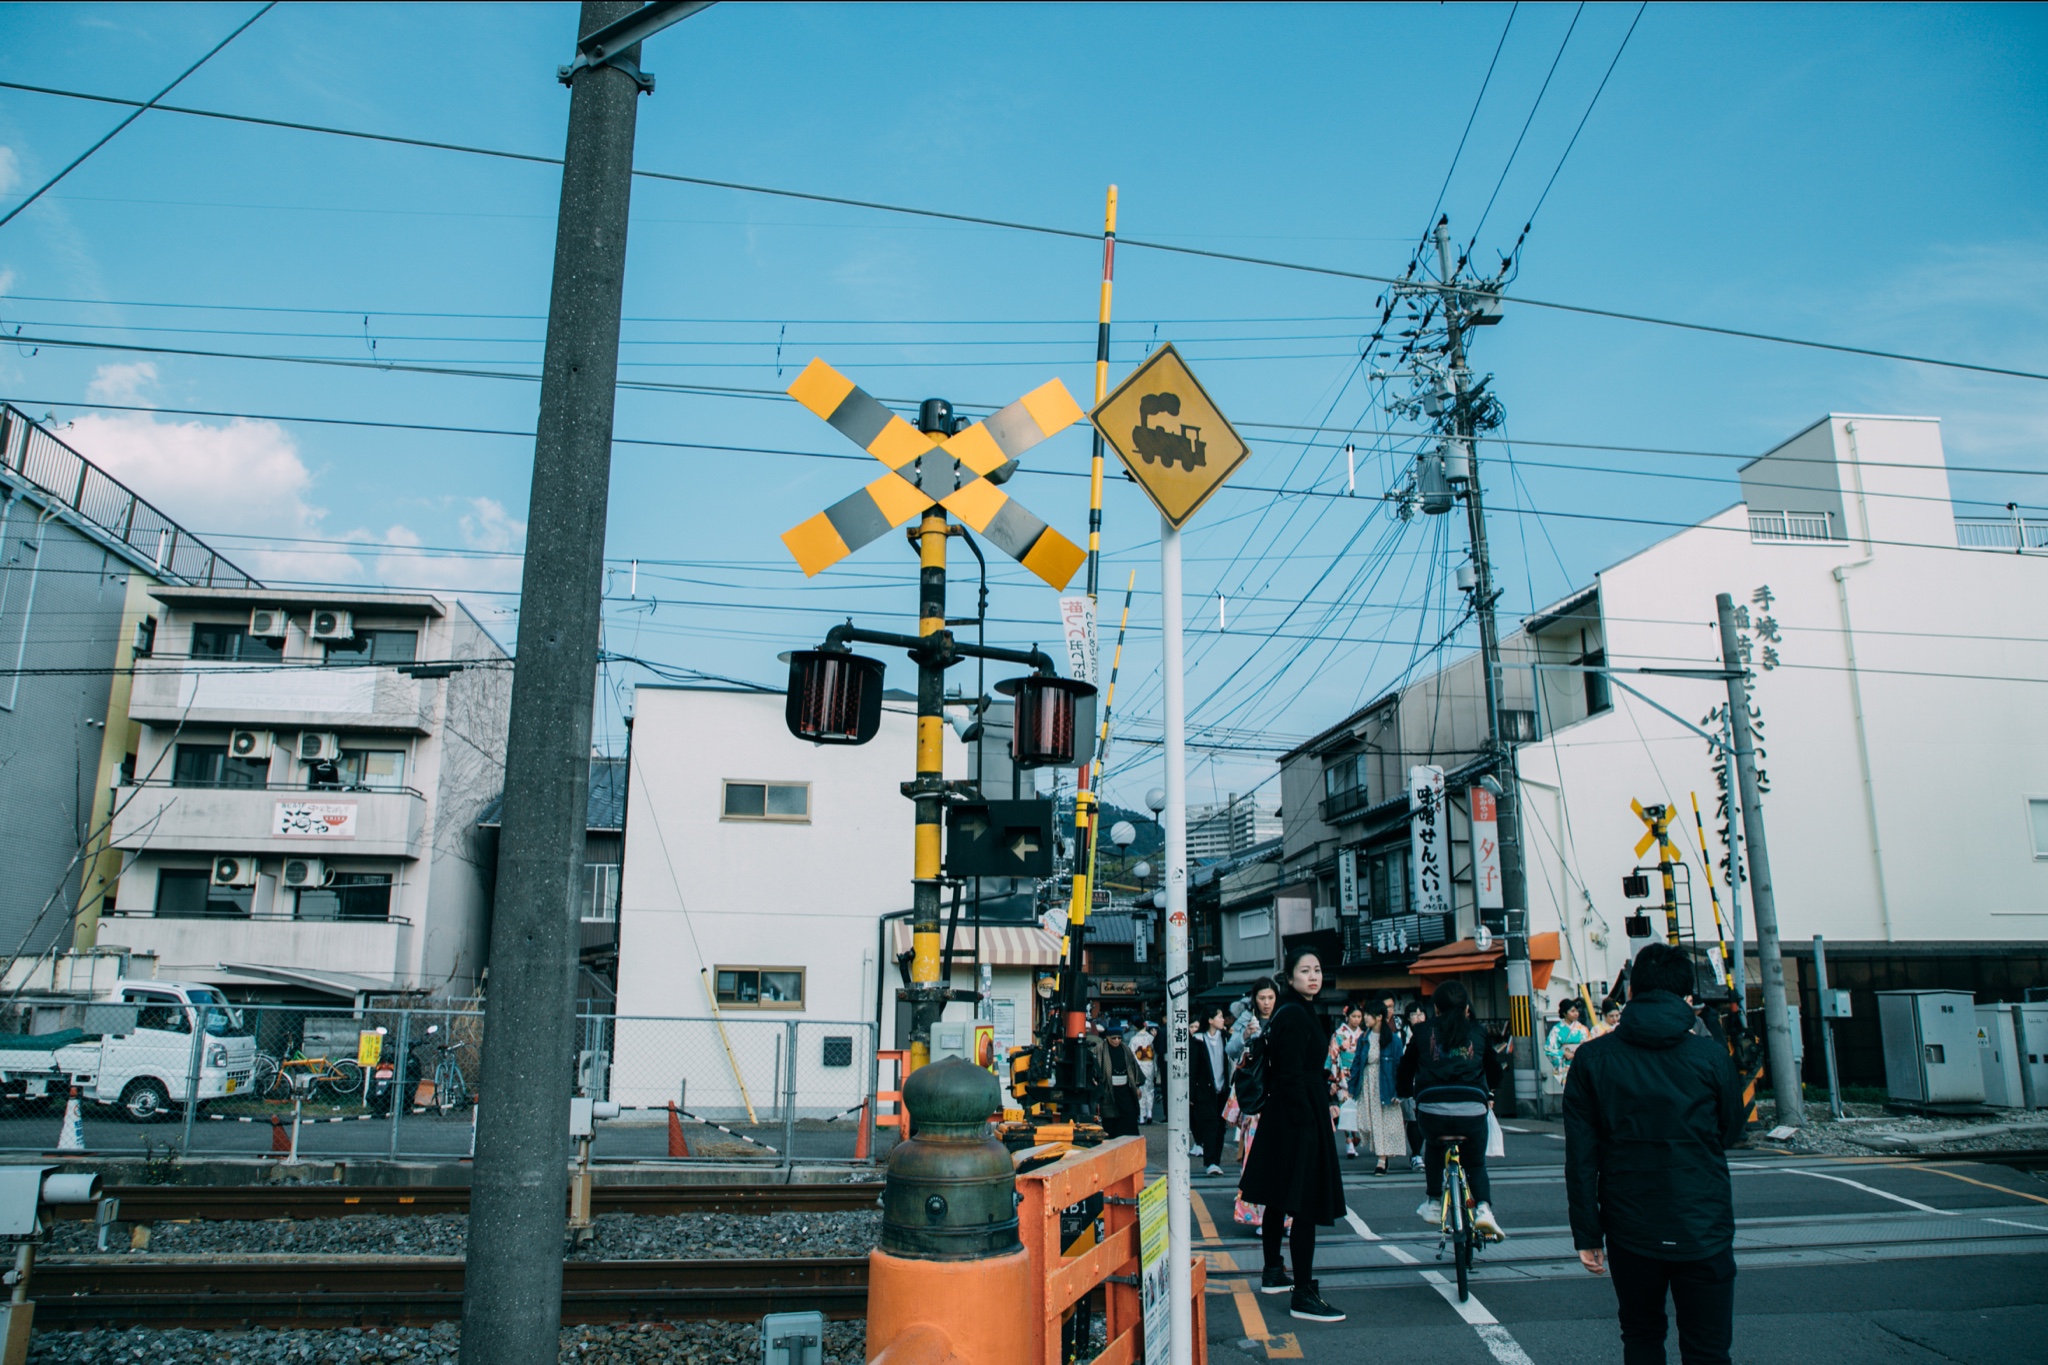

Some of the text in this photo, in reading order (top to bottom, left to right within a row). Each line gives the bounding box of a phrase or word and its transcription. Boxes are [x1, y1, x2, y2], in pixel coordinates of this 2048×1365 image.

[1062, 600, 1086, 682] 押して出て下さ
[1751, 584, 1782, 671] 手焼き
[1478, 791, 1489, 821] おみやげ
[1478, 837, 1499, 893] 夕子
[1174, 1009, 1188, 1062] 京都市
[1062, 1200, 1087, 1214] B1
